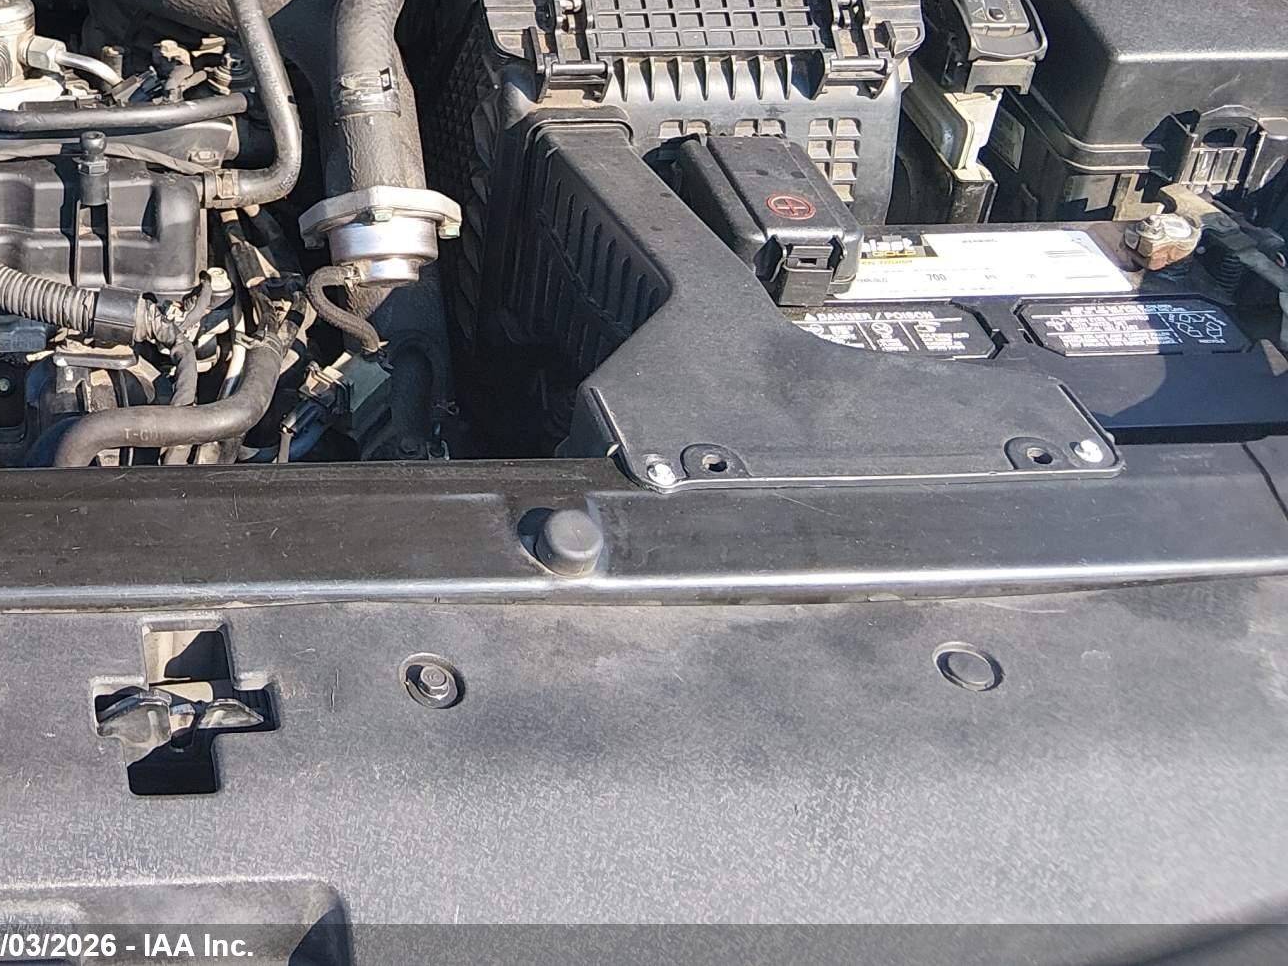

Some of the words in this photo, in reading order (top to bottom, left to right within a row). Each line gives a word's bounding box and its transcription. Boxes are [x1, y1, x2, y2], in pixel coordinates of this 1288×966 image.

[925, 273, 948, 282] 700
[817, 311, 872, 321] DANGER
[884, 310, 935, 320] POISON
